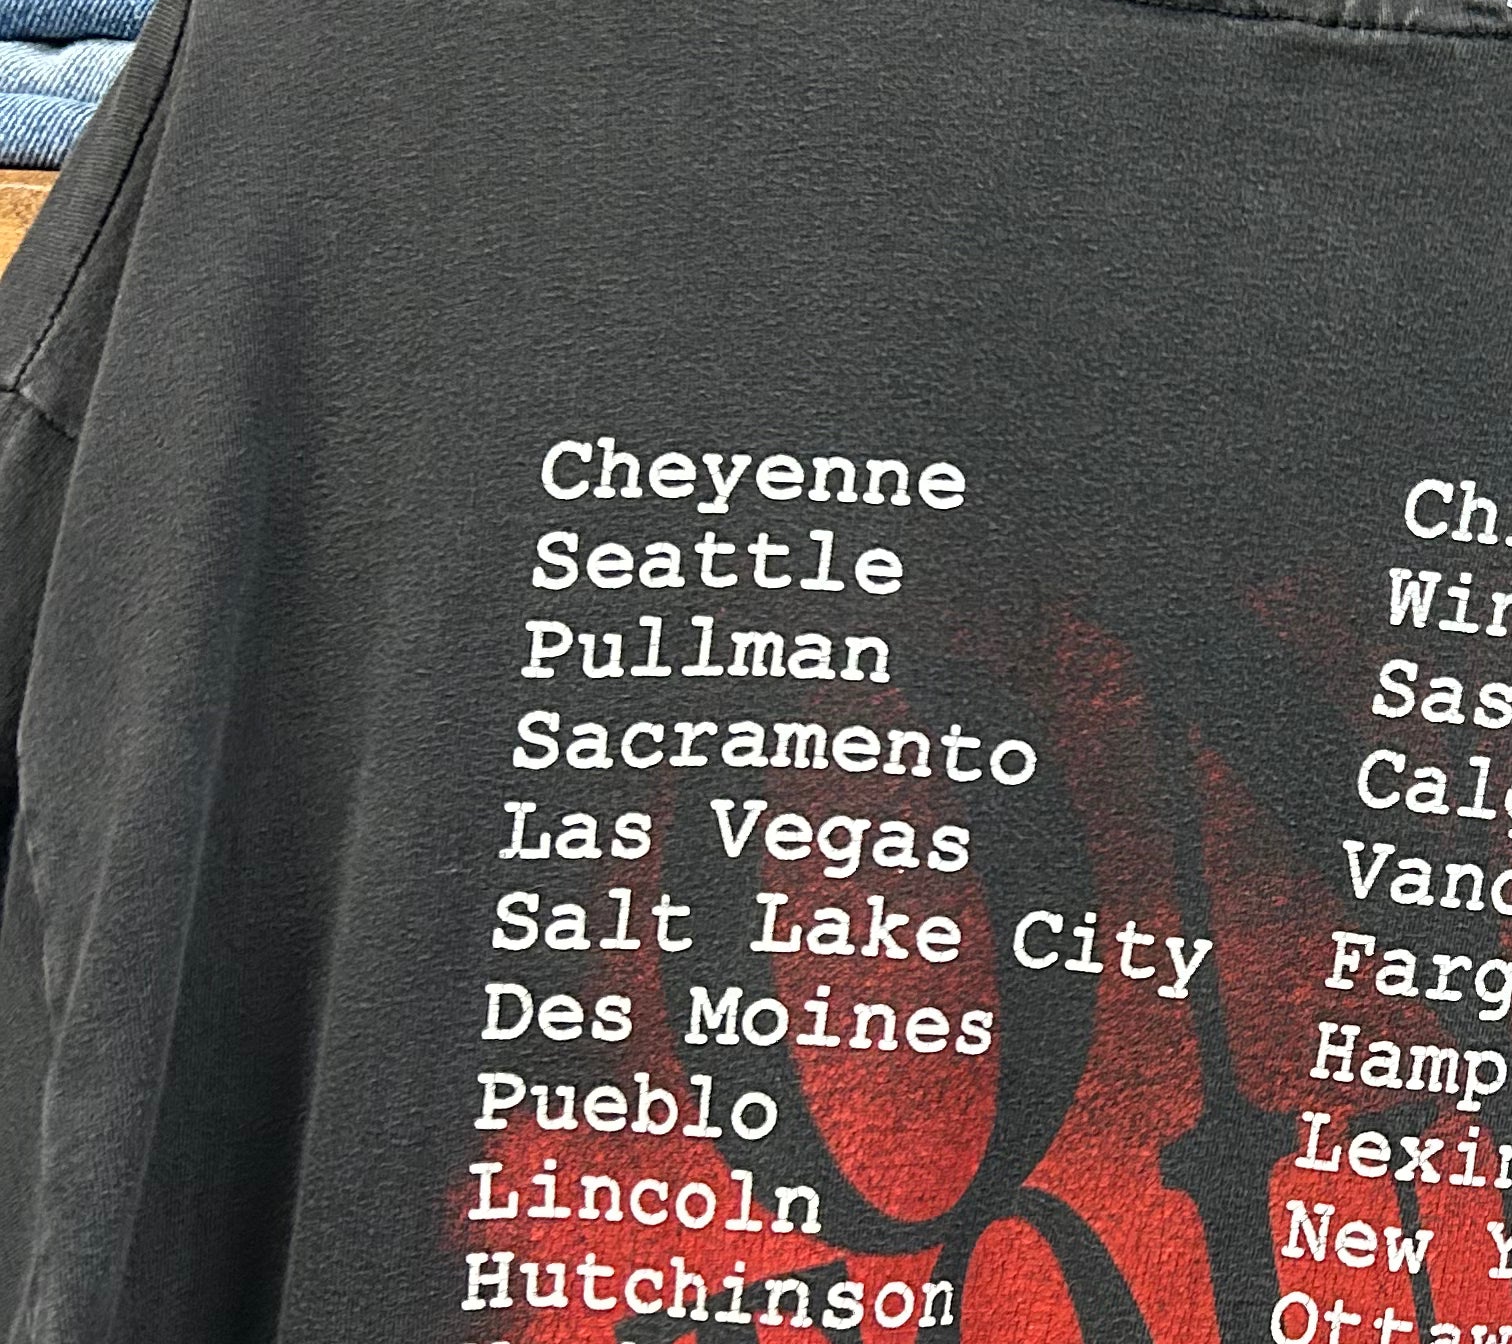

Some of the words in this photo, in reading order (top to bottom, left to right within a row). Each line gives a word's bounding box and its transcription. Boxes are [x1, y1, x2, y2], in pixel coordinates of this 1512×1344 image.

[542, 437, 965, 513] Cheyenne
[532, 530, 903, 594] Seattle
[521, 615, 890, 683] Pullman
[513, 710, 1037, 785] Sacramento
[499, 802, 651, 859] Las
[710, 799, 969, 878] Vegas
[492, 888, 692, 952] Salt
[750, 893, 961, 962] Lake
[1013, 911, 1213, 998] City
[481, 983, 632, 1041] Des
[685, 985, 993, 1055] Moines
[474, 1072, 777, 1140] Pueblo
[468, 1159, 821, 1233] Lincoln
[1281, 1200, 1434, 1274] New
[461, 1252, 953, 1329] Hutchinson
